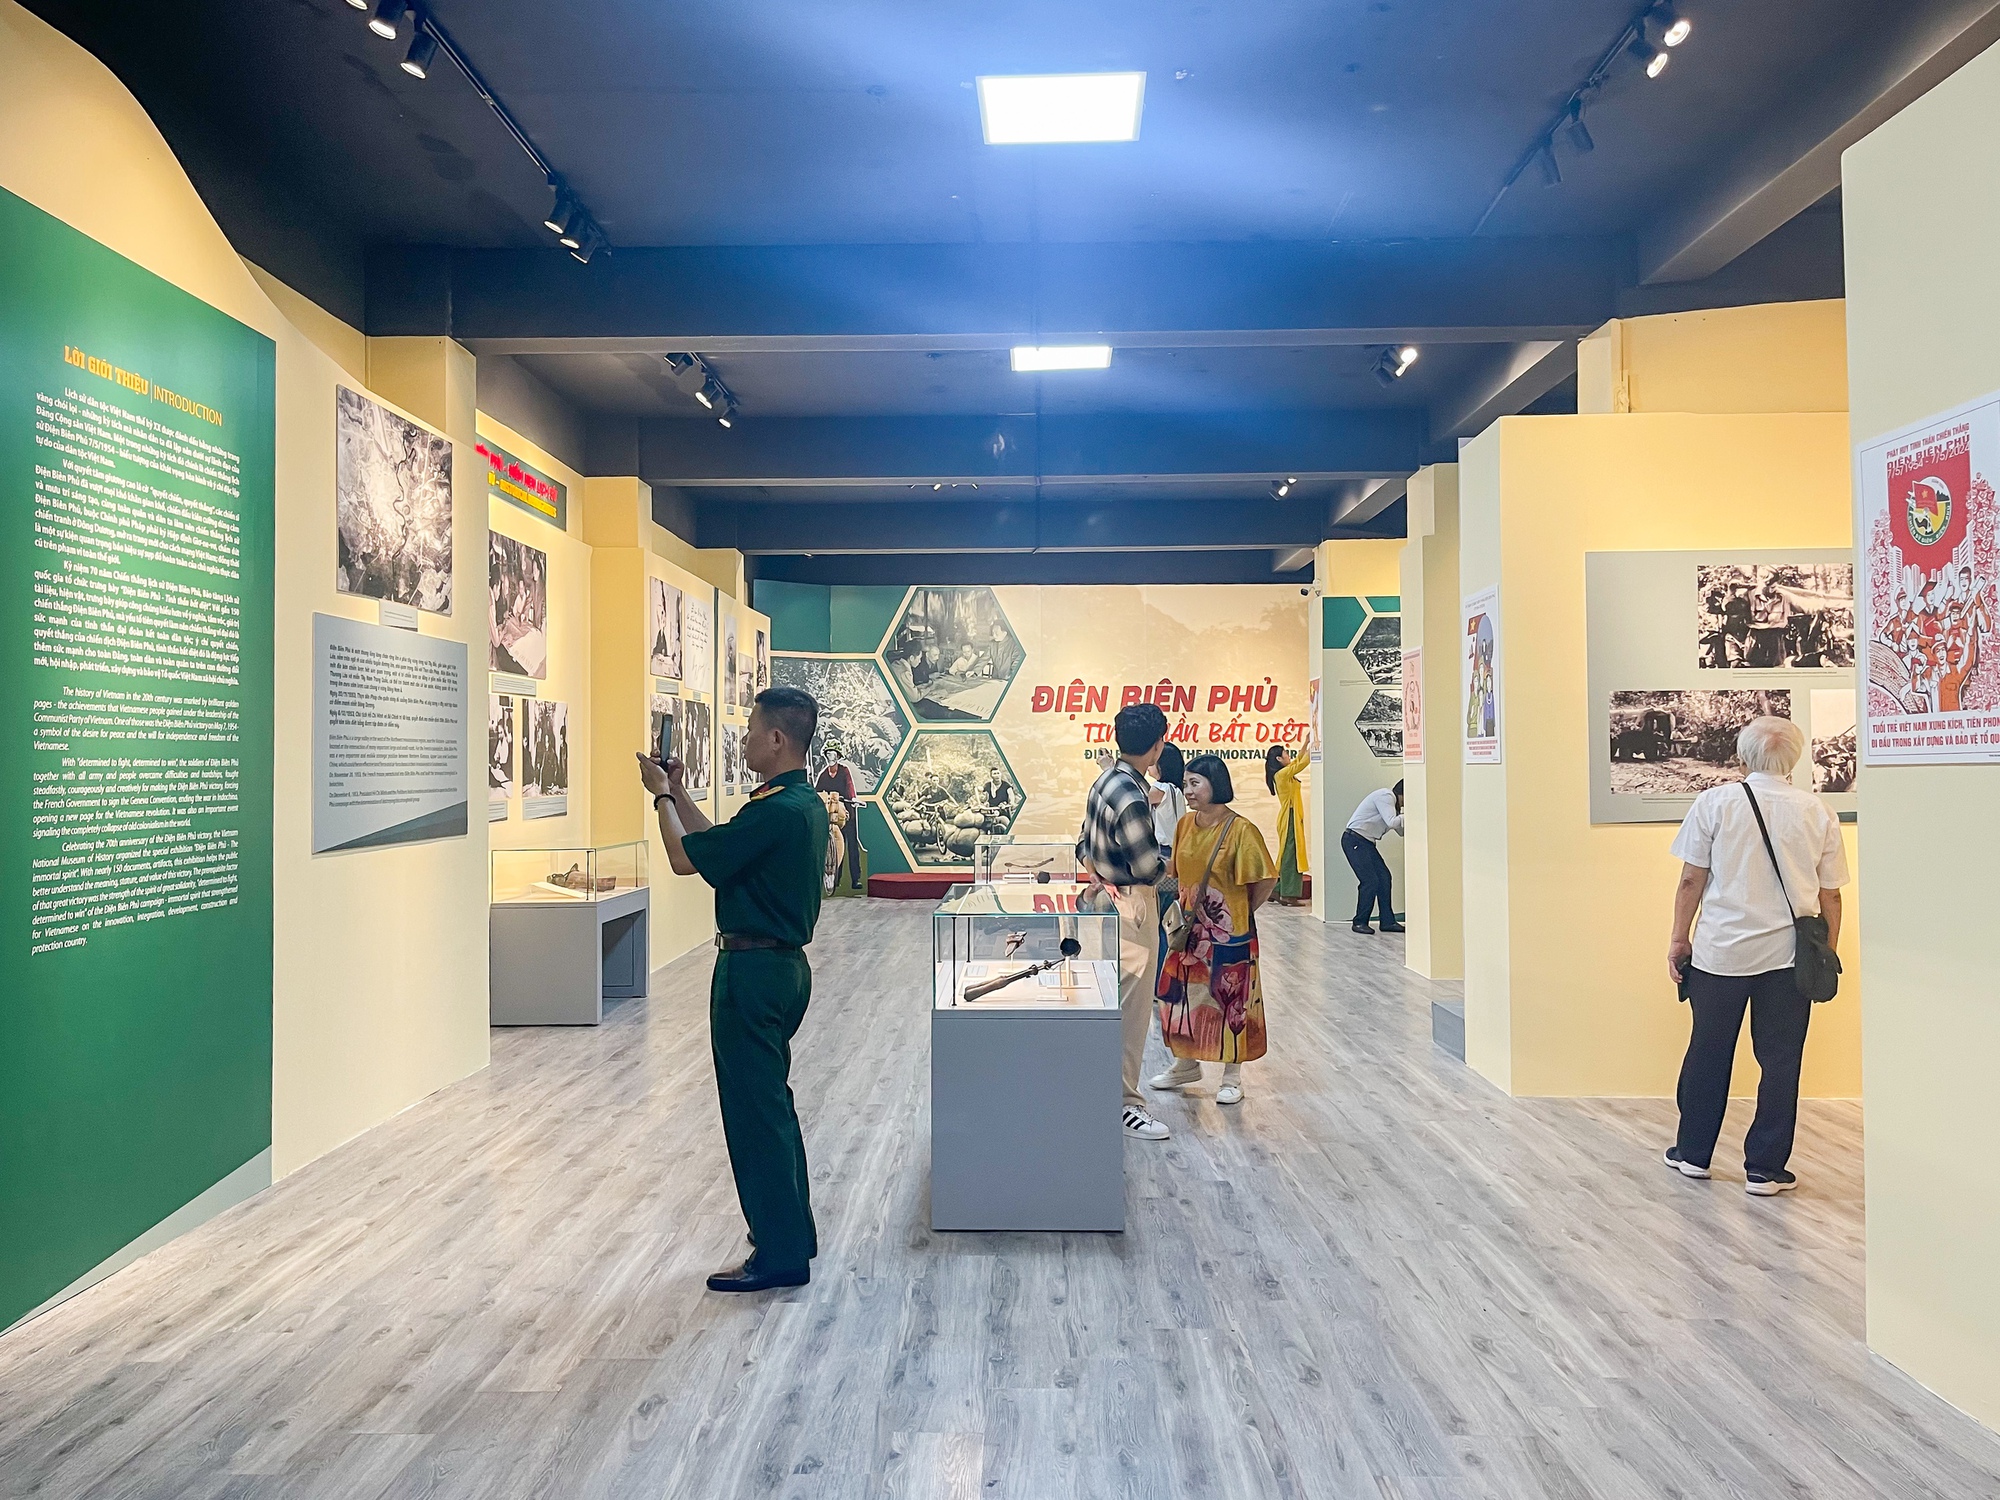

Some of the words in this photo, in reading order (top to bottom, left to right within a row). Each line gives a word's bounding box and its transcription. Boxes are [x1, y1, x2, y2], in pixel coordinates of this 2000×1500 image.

[64, 345, 85, 369] LỜI
[88, 356, 112, 380] GIỚI
[115, 367, 148, 395] THIỆU
[36, 392, 53, 407] vàng
[154, 385, 222, 426] INTRODUCTION
[55, 412, 72, 427] Cộng
[84, 422, 96, 435] Việt
[88, 438, 115, 454] 7/5/1954
[1900, 445, 1909, 454] HUY
[1937, 428, 1951, 441] CHIẾN
[1947, 432, 1969, 449] PHỦ
[1887, 461, 1923, 478] 7/5/1954
[1931, 444, 1970, 463] 7/5/2024
[35, 464, 51, 478] Điện
[52, 469, 66, 482] Biên
[35, 480, 43, 489] và
[34, 569, 51, 580] quốc
[52, 573, 63, 583] gia
[63, 686, 74, 696] The
[75, 687, 94, 699] history
[95, 689, 102, 697] of
[103, 690, 125, 699] Vietnam
[126, 691, 131, 699] in
[132, 692, 141, 700] the
[142, 693, 153, 701] 20th
[154, 696, 172, 704] century
[1032, 678, 1109, 720] ĐIỆN
[1121, 678, 1196, 712] BIÊN
[1207, 677, 1278, 712] PHỦ
[33, 700, 52, 710] pages
[57, 700, 67, 709] the
[68, 701, 106, 711] achievements
[107, 703, 119, 712] that
[120, 704, 148, 714] Vietnamese
[149, 707, 165, 716] people
[166, 708, 182, 717] gained
[33, 712, 68, 723] Communist
[68, 714, 84, 725] Party
[1887, 720, 1897, 732] TRẺ
[1899, 721, 1911, 734] VIỆT
[1913, 721, 1927, 731] NAM
[1929, 720, 1946, 730] XUNG
[1948, 718, 1964, 730] KÍCH,
[1966, 716, 1980, 728] TIÊN
[1983, 717, 2000, 727] PHON
[40, 727, 62, 738] symbol
[63, 727, 70, 736] of
[71, 728, 81, 737] the
[82, 728, 99, 737] desire
[100, 729, 108, 737] for
[109, 731, 125, 739] peace
[126, 730, 137, 738] and
[138, 730, 147, 739] the
[1084, 722, 1116, 743] TIN
[1164, 713, 1199, 743] ẦN
[1209, 713, 1251, 743] BẤT
[1256, 718, 1309, 748] DIỆT
[34, 741, 69, 750] Vietnamese.
[1892, 737, 1911, 747] TRONG
[1913, 735, 1925, 746] XÂY
[1926, 736, 1943, 748] DỰNG
[1946, 734, 1953, 745] VÀ
[1956, 731, 1968, 744] BẢO
[1970, 733, 1978, 746] VỆ
[1990, 733, 2000, 744] QU
[62, 758, 75, 766] With
[118, 757, 131, 768] fight,
[1206, 750, 1267, 759] IMMORTAL
[33, 771, 59, 783] together
[62, 771, 75, 780] with
[78, 771, 86, 780] all
[89, 773, 103, 781] army
[106, 771, 117, 779] and
[119, 771, 136, 781] people
[33, 785, 66, 796] steadfastly,
[67, 784, 105, 795] courageously
[105, 784, 116, 792] and
[117, 784, 141, 794] creatively
[33, 800, 43, 809] the
[44, 799, 64, 808] French
[66, 798, 100, 807] Government
[108, 797, 119, 808] sign
[120, 797, 129, 805] the
[130, 796, 148, 804] Geneva
[33, 813, 58, 825] opening
[79, 813, 94, 822] page
[95, 810, 103, 819] for
[105, 810, 114, 819] the
[115, 810, 144, 818] Vietnamese
[32, 827, 60, 839] signaling
[61, 826, 70, 835] the
[70, 824, 102, 835] completely
[62, 841, 94, 851] Celebrating
[95, 840, 104, 848] the
[106, 838, 118, 847] 70th
[119, 838, 148, 846] anniversary
[32, 856, 59, 868] National
[61, 856, 85, 865] Museum
[87, 853, 94, 862] of
[95, 853, 114, 862] History
[115, 849, 141, 861] organized
[142, 848, 151, 856] the
[32, 870, 61, 882] immortal
[80, 867, 93, 876] With
[94, 865, 112, 876] nearly
[113, 864, 122, 873] 150
[123, 862, 152, 872] documents,
[32, 929, 41, 939] for
[45, 925, 79, 936] Vietnamese
[92, 920, 102, 928] the
[104, 916, 134, 926] innovation,
[31, 941, 63, 956] protection
[64, 937, 87, 947] country.
